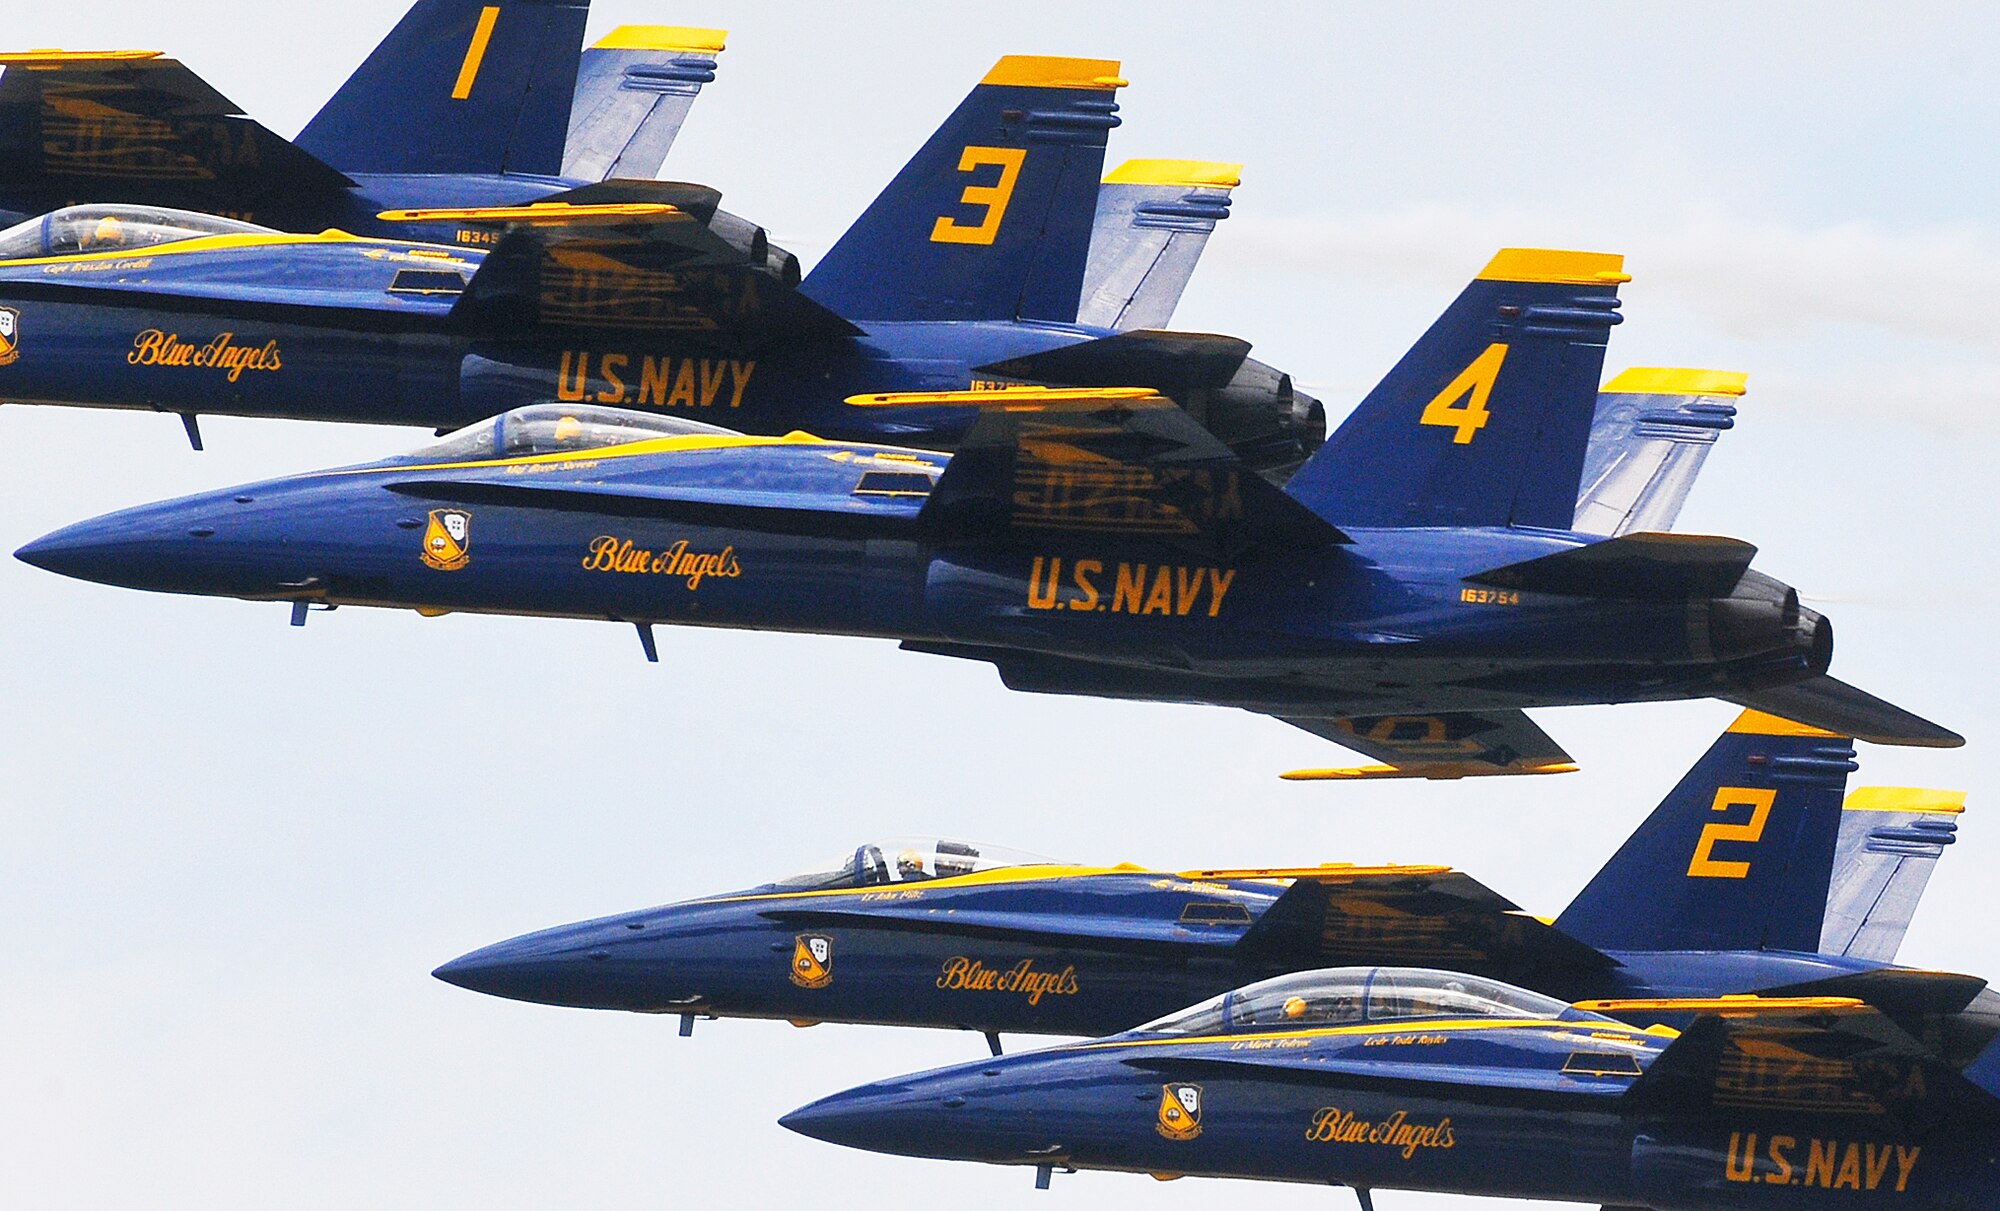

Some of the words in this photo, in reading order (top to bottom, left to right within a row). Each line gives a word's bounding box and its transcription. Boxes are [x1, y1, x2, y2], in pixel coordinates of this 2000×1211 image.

[451, 6, 501, 100] 1
[929, 145, 1028, 246] 3
[127, 328, 195, 366] Blue
[193, 331, 283, 383] Angels
[1419, 342, 1510, 445] 4
[581, 535, 653, 575] Blue
[651, 539, 742, 591] Angels
[1460, 588, 1519, 605] 163754
[1686, 785, 1778, 879] 2
[936, 955, 999, 992] Blue
[997, 958, 1079, 1007] Angels
[1305, 1106, 1371, 1144] Blue
[1368, 1110, 1455, 1160] Angels
